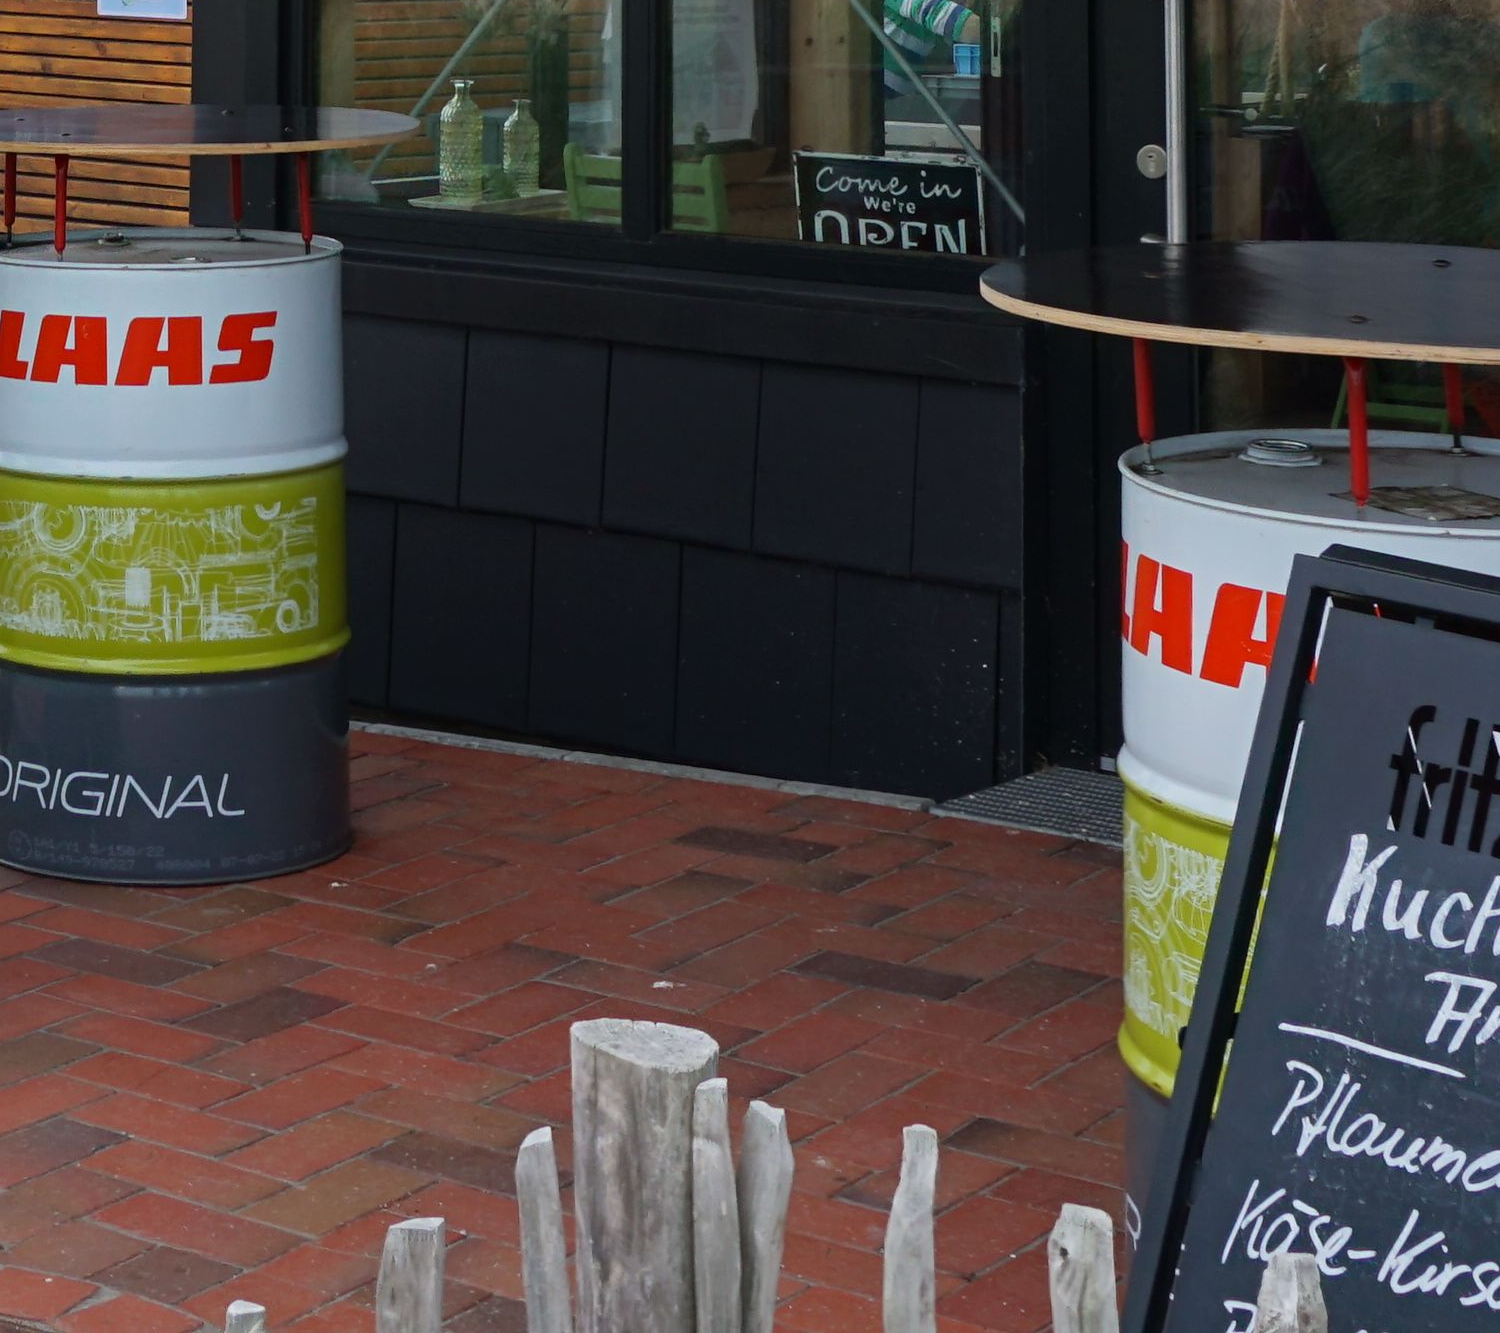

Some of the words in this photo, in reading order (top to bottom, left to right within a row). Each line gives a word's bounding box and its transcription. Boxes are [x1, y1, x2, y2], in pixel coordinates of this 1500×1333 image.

[815, 166, 908, 197] Come
[920, 170, 962, 199] in
[864, 195, 917, 214] We're
